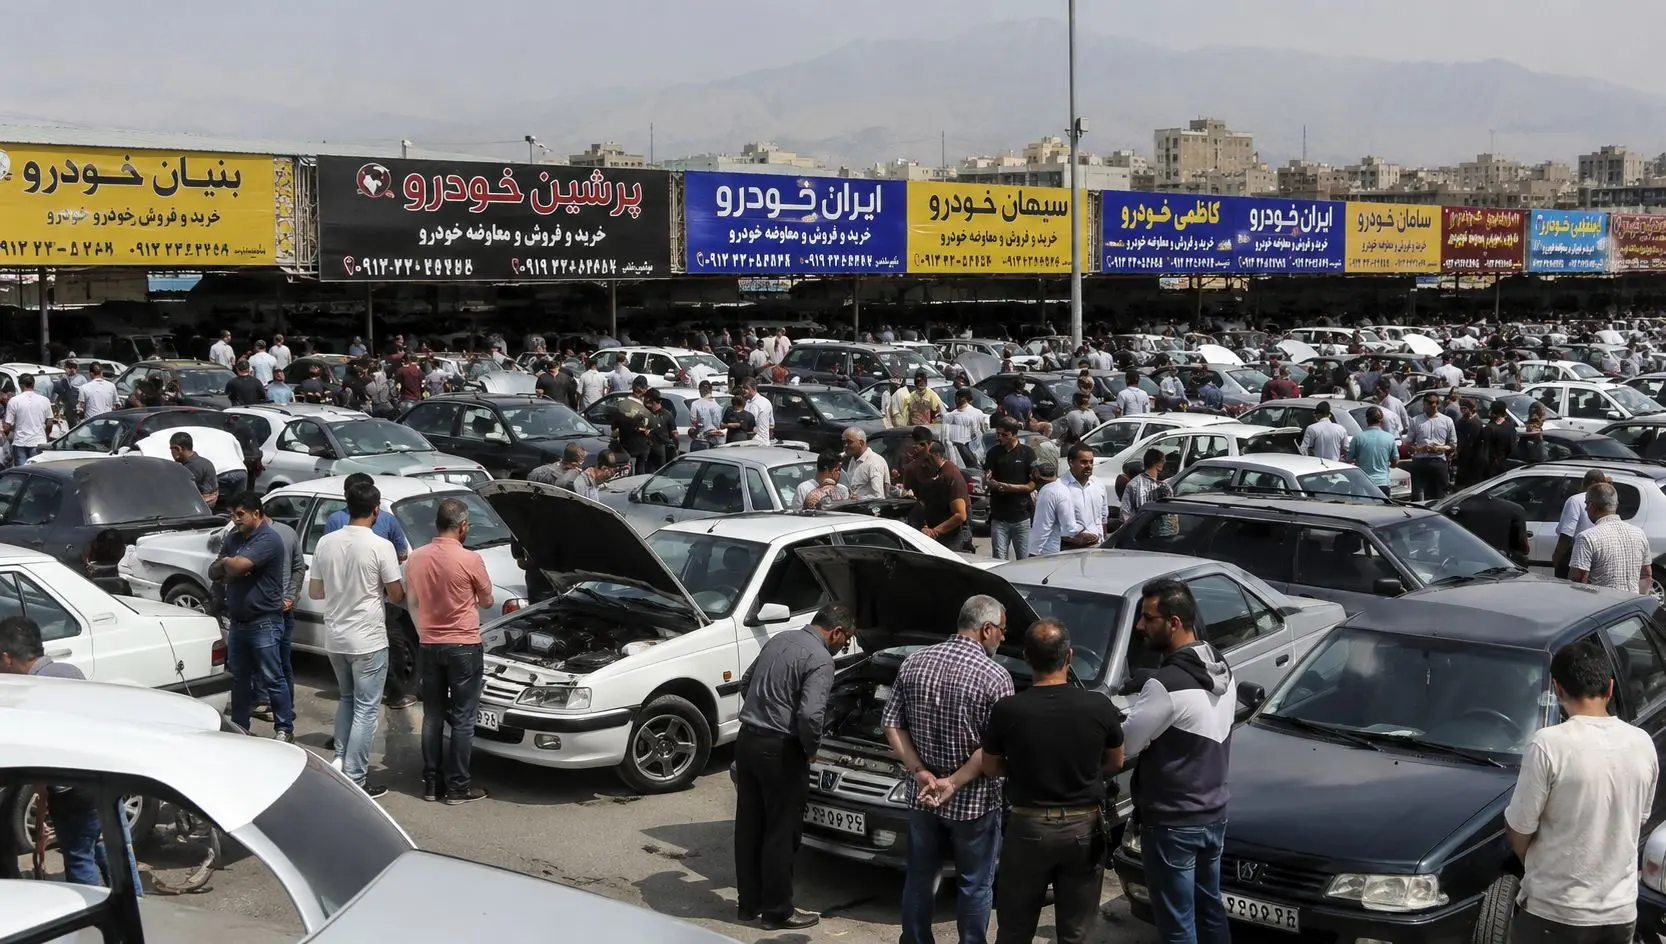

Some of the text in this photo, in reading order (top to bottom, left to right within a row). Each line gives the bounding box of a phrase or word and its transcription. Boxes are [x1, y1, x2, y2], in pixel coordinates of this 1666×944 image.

[23, 155, 241, 198] بنیان خودرو
[403, 167, 643, 218] پرشین خودرو
[716, 180, 881, 221] ایران خودرو
[929, 190, 997, 222] خودرو
[1121, 199, 1221, 230] کاظمی خودرو
[181, 212, 187, 227] و
[191, 209, 220, 227] خرید
[1250, 203, 1333, 233] ایران خودرو
[1358, 208, 1394, 232] خودرو
[1397, 208, 1431, 233] سامان
[419, 222, 606, 248] خرید و فروش و معاوضه خودرو
[729, 225, 762, 243] خودرو
[801, 232, 807, 244] و
[809, 225, 837, 244] فروش
[840, 232, 845, 244] و
[847, 226, 871, 245] خرید
[940, 230, 967, 246] خودرو
[1038, 234, 1057, 248] خرید
